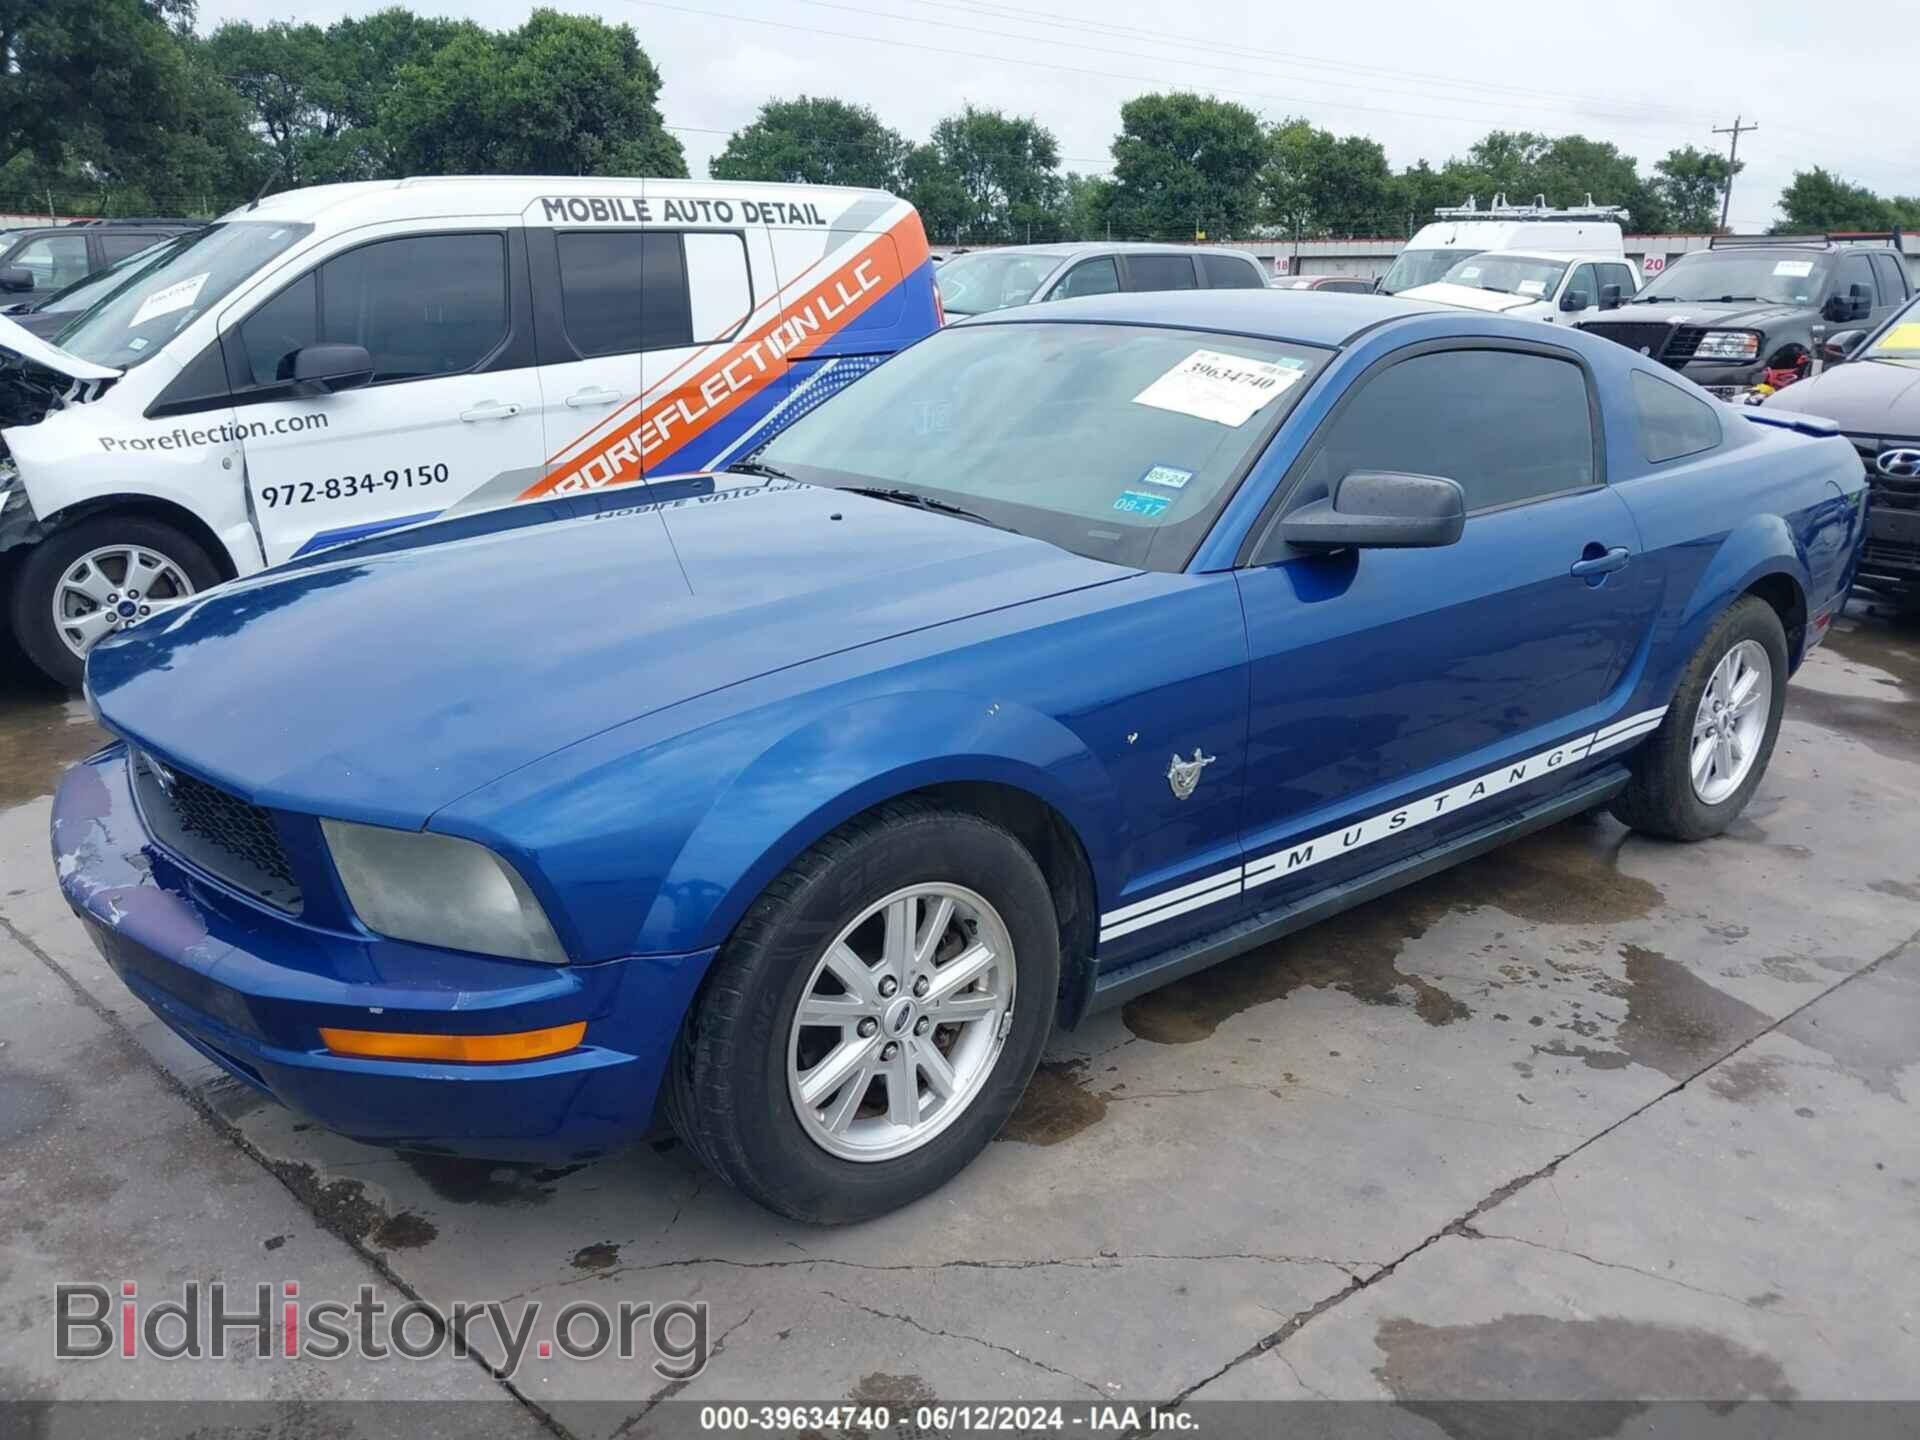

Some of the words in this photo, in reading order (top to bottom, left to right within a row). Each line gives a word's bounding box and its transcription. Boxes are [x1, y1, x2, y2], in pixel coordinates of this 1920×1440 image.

[541, 198, 652, 223] MOBILE
[664, 200, 734, 223] AUTO
[740, 201, 827, 225] DETAIL
[1645, 258, 1664, 271] 20
[543, 305, 820, 497] ROREFLECTION
[817, 258, 881, 320] LLC
[1184, 362, 1276, 390] 39634740
[99, 410, 329, 452] Proreflection.com
[261, 462, 449, 508] 972-834-9150
[1113, 498, 1168, 517] 08-17
